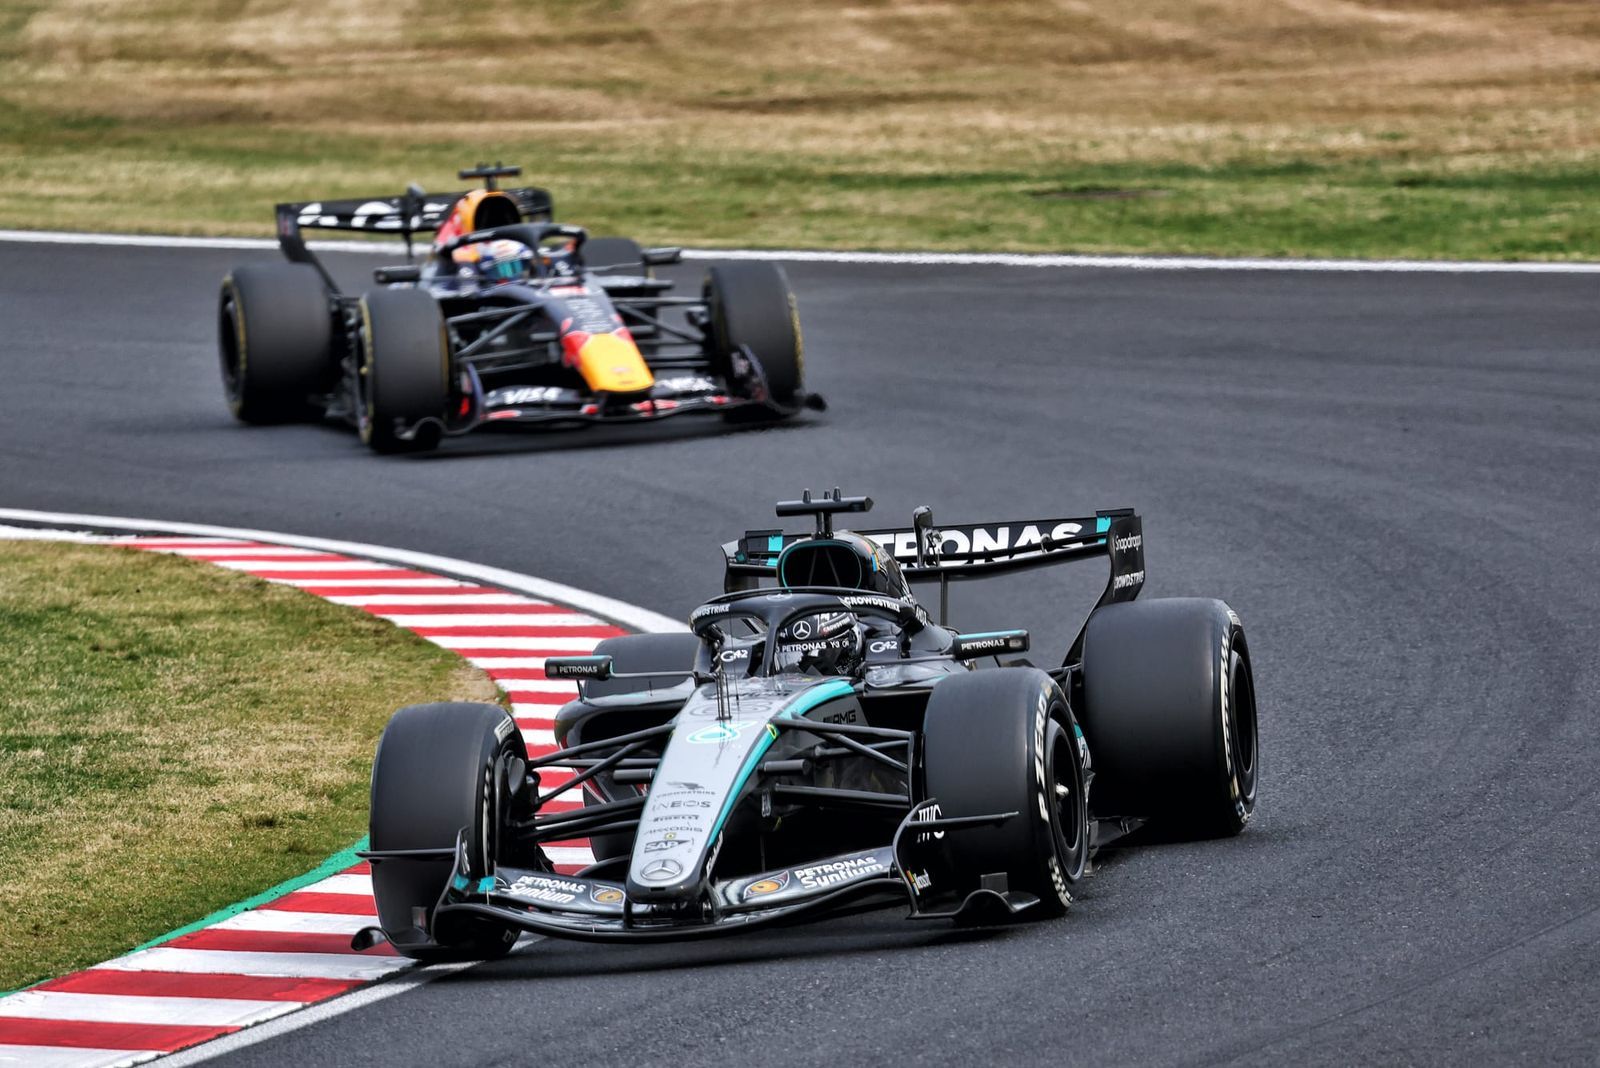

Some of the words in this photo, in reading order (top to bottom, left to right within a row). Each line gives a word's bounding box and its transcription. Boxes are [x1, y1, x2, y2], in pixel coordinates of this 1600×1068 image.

[782, 641, 827, 652] PETRONAS
[869, 641, 898, 653] G42
[961, 638, 1005, 651] PETRONAS
[559, 665, 598, 673] PETRONAS
[652, 800, 712, 811] INEOS
[645, 840, 682, 852] SAP
[795, 856, 877, 879] PETRONAS
[517, 876, 587, 893] PETRONAS
